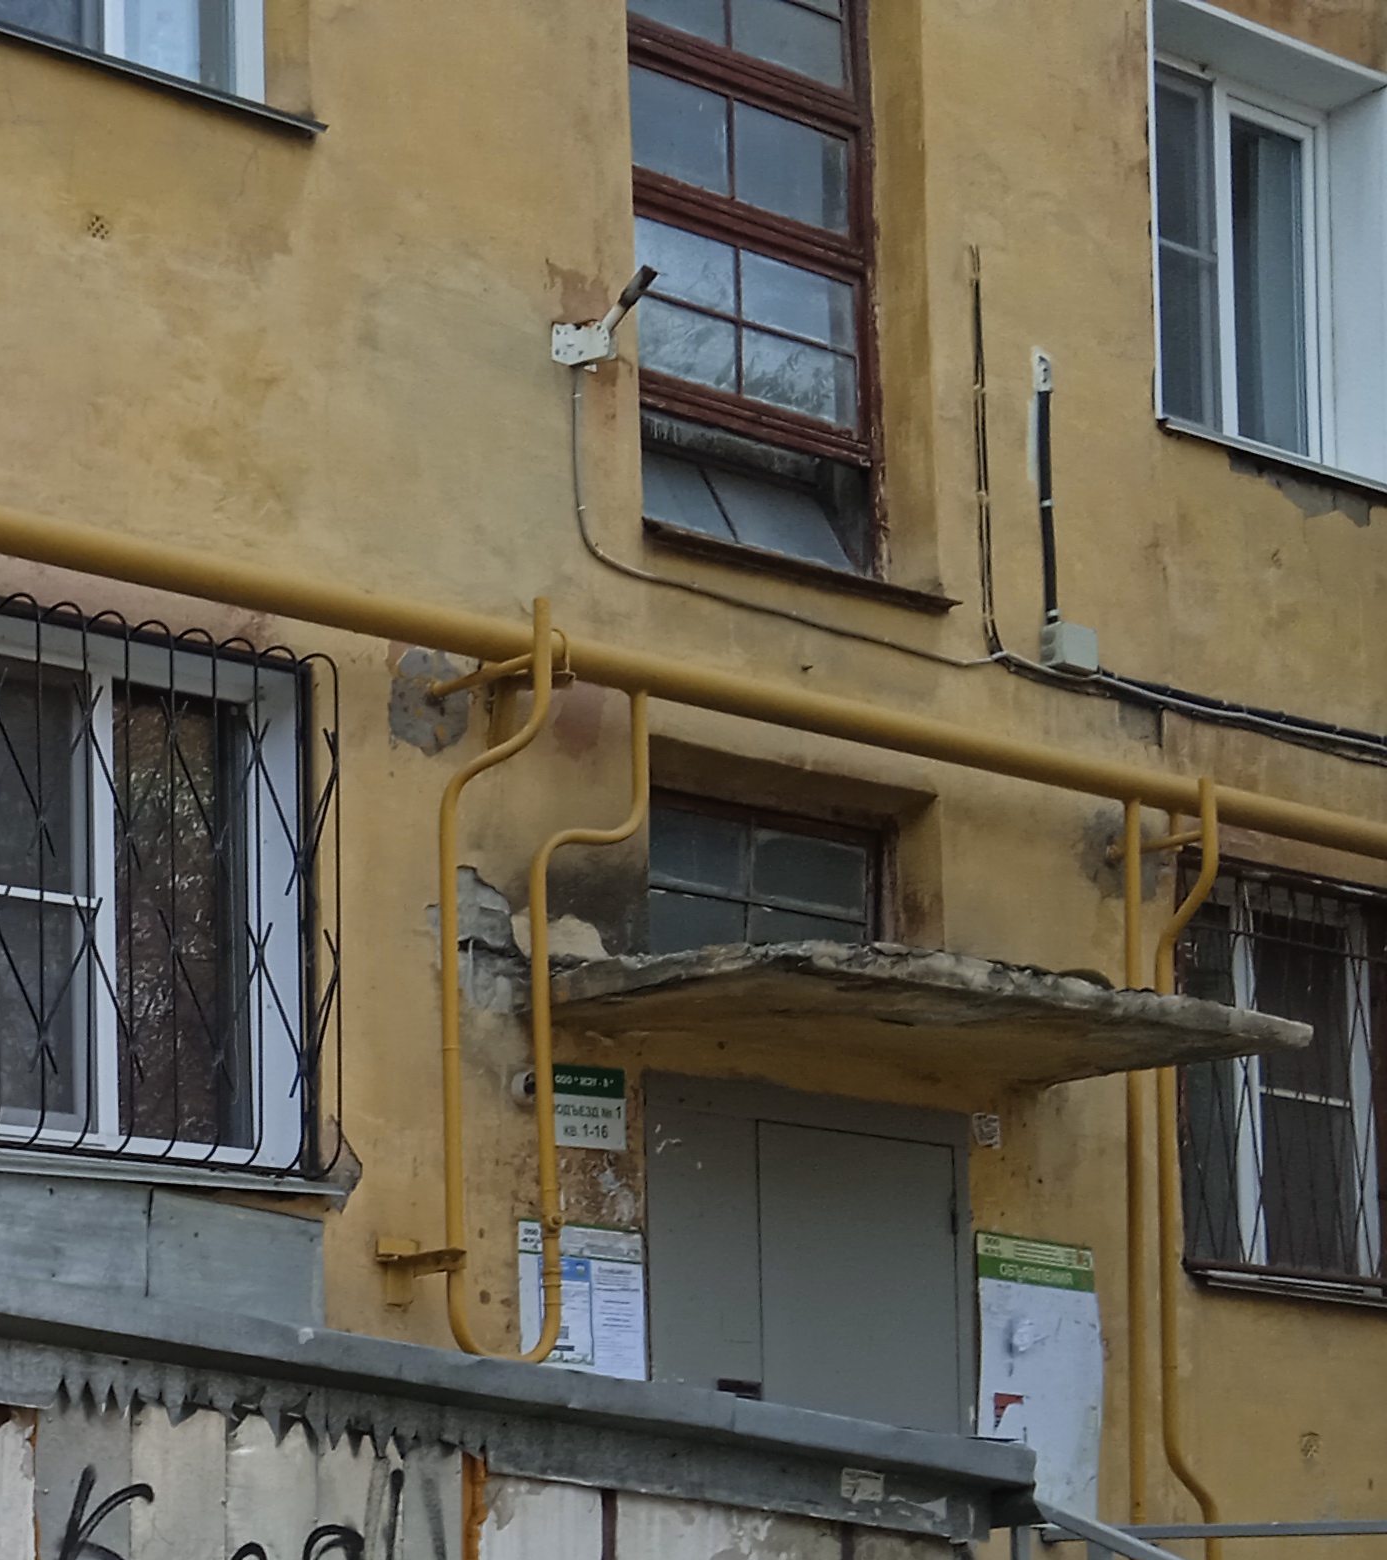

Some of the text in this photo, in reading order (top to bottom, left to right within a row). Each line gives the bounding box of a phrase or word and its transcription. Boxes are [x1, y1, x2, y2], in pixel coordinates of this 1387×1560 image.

[555, 1103, 600, 1118] ОДЪЕЗД
[615, 1105, 622, 1119] 1
[581, 1122, 609, 1139] 1-16
